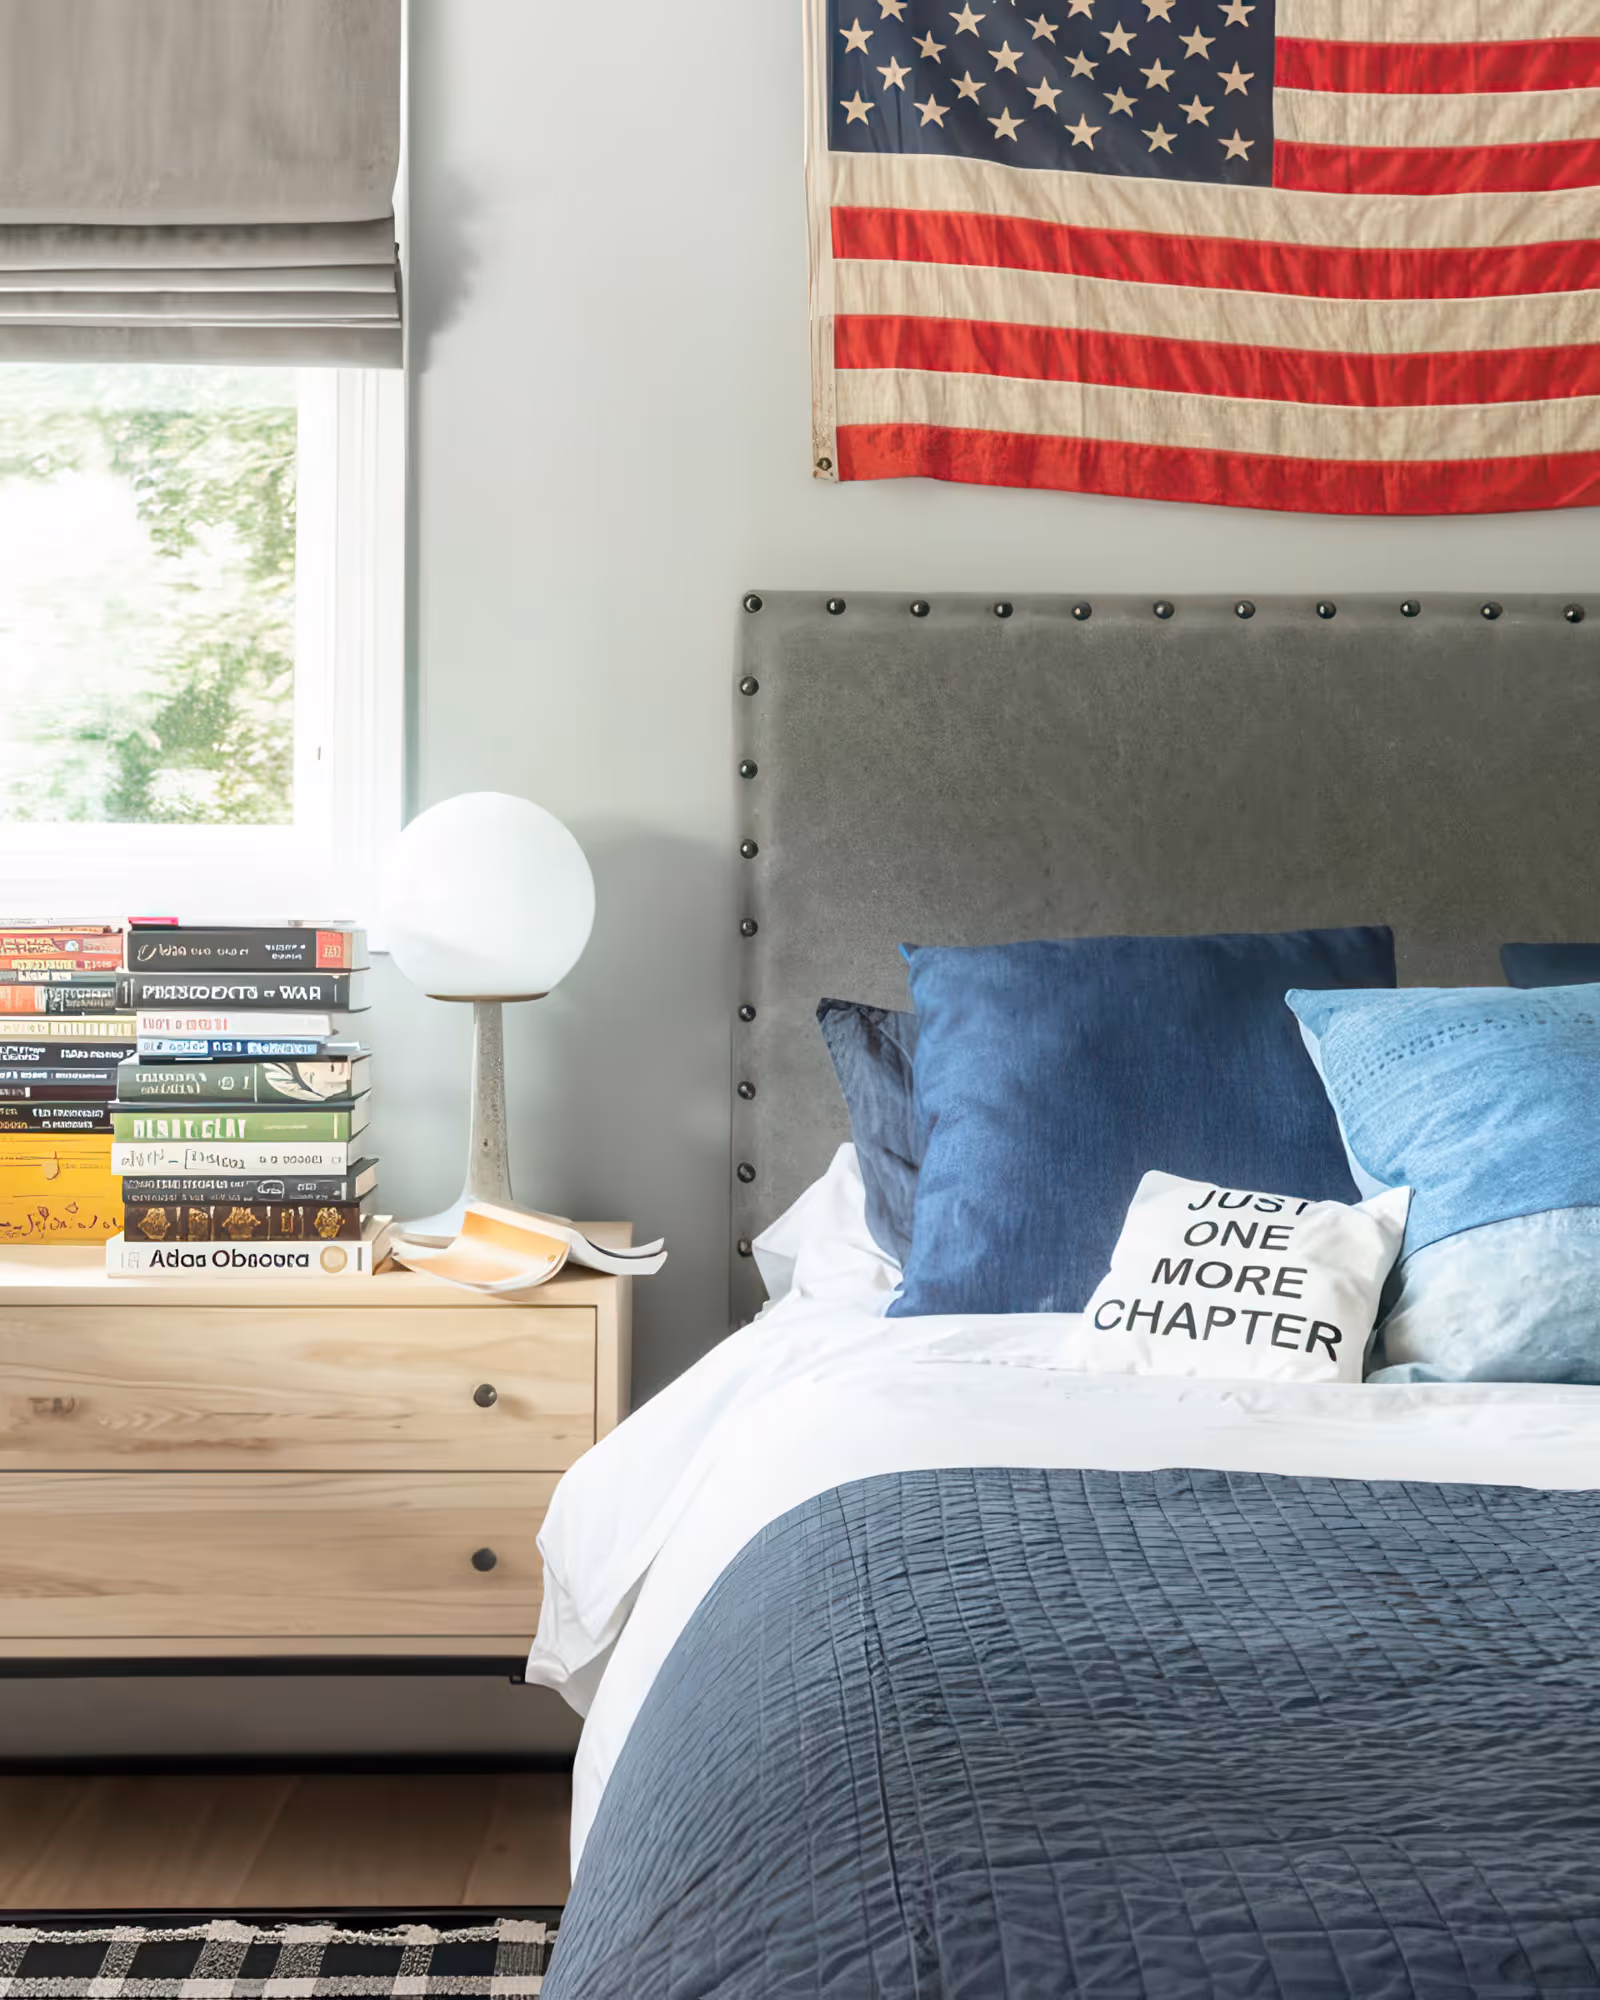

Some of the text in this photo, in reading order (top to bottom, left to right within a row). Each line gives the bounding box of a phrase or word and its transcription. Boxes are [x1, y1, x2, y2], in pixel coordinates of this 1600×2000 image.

[1184, 1220, 1295, 1251] ONE
[1151, 1258, 1308, 1300] MORE
[1094, 1298, 1342, 1362] CHAPTER
